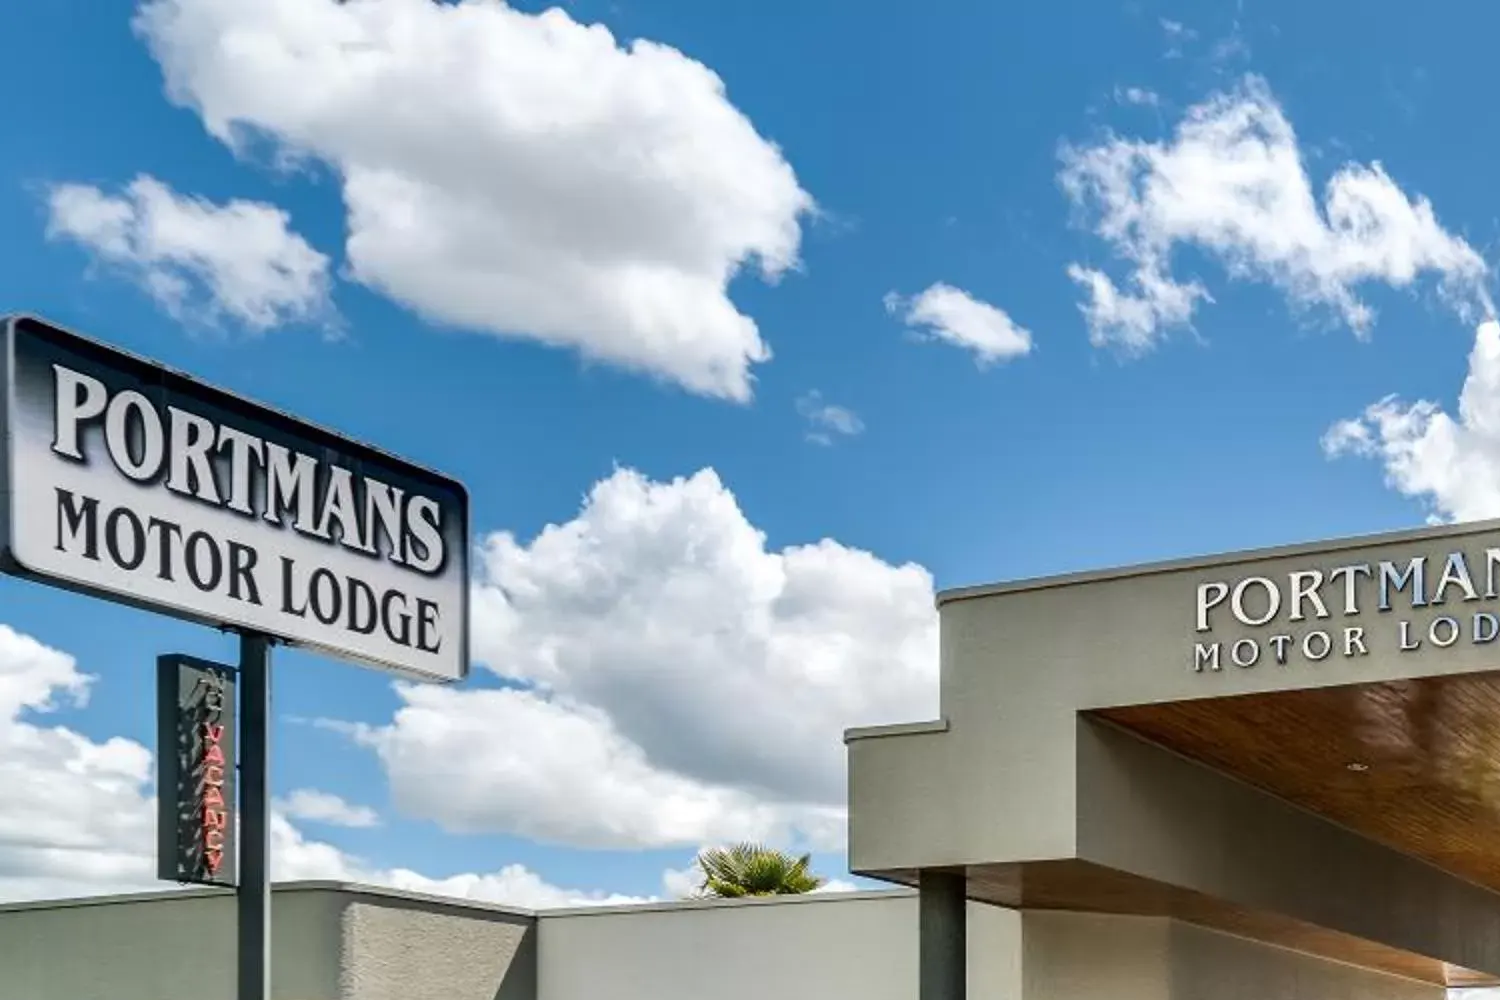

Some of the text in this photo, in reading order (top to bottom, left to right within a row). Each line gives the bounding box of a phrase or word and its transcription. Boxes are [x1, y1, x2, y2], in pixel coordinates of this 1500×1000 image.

[51, 363, 446, 576] PORTMANS
[54, 487, 442, 655] MOTOR LODGE
[1193, 626, 1368, 671] MOTOR
